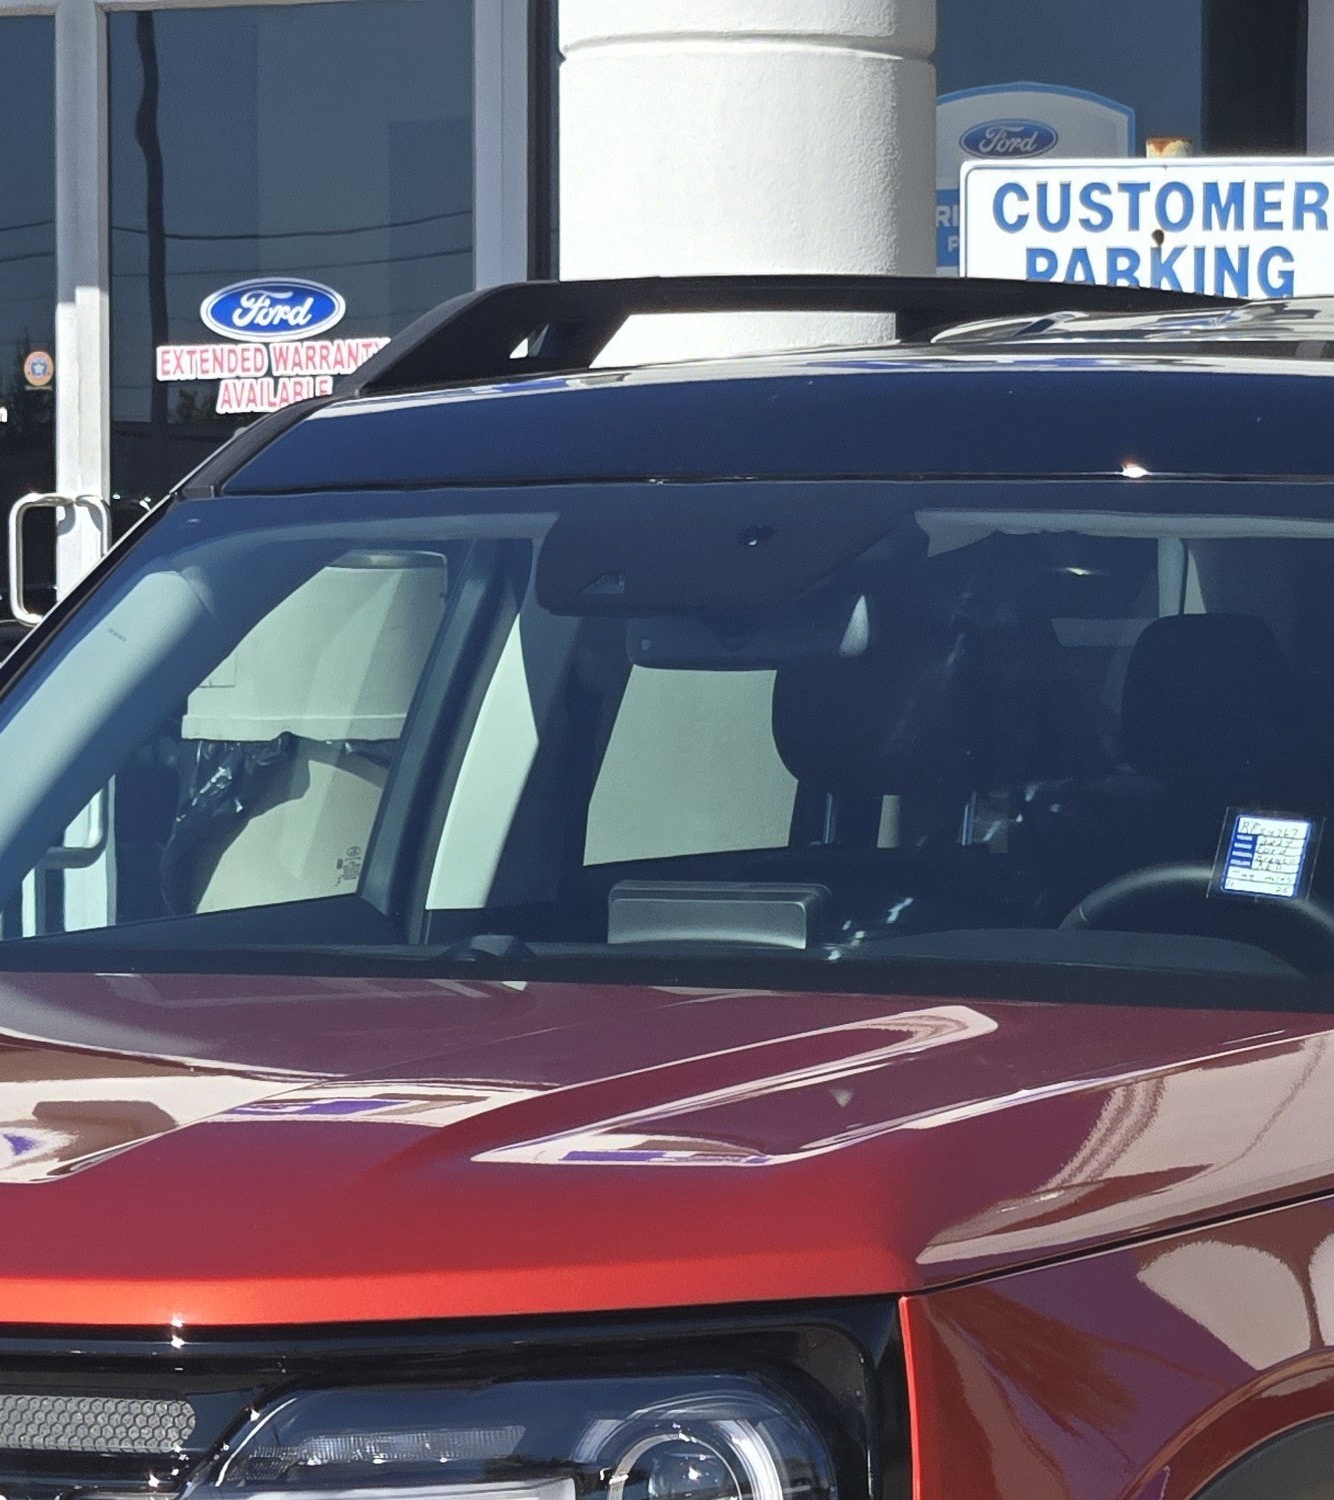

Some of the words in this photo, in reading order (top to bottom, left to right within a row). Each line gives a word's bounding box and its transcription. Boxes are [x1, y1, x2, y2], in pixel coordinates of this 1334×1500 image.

[978, 125, 1038, 153] Ford
[992, 181, 1330, 233] CUSTOMER
[1025, 246, 1295, 298] PARKING
[232, 289, 315, 328] Ford
[161, 345, 265, 377] EXTENDED
[272, 341, 382, 371] WARRANT
